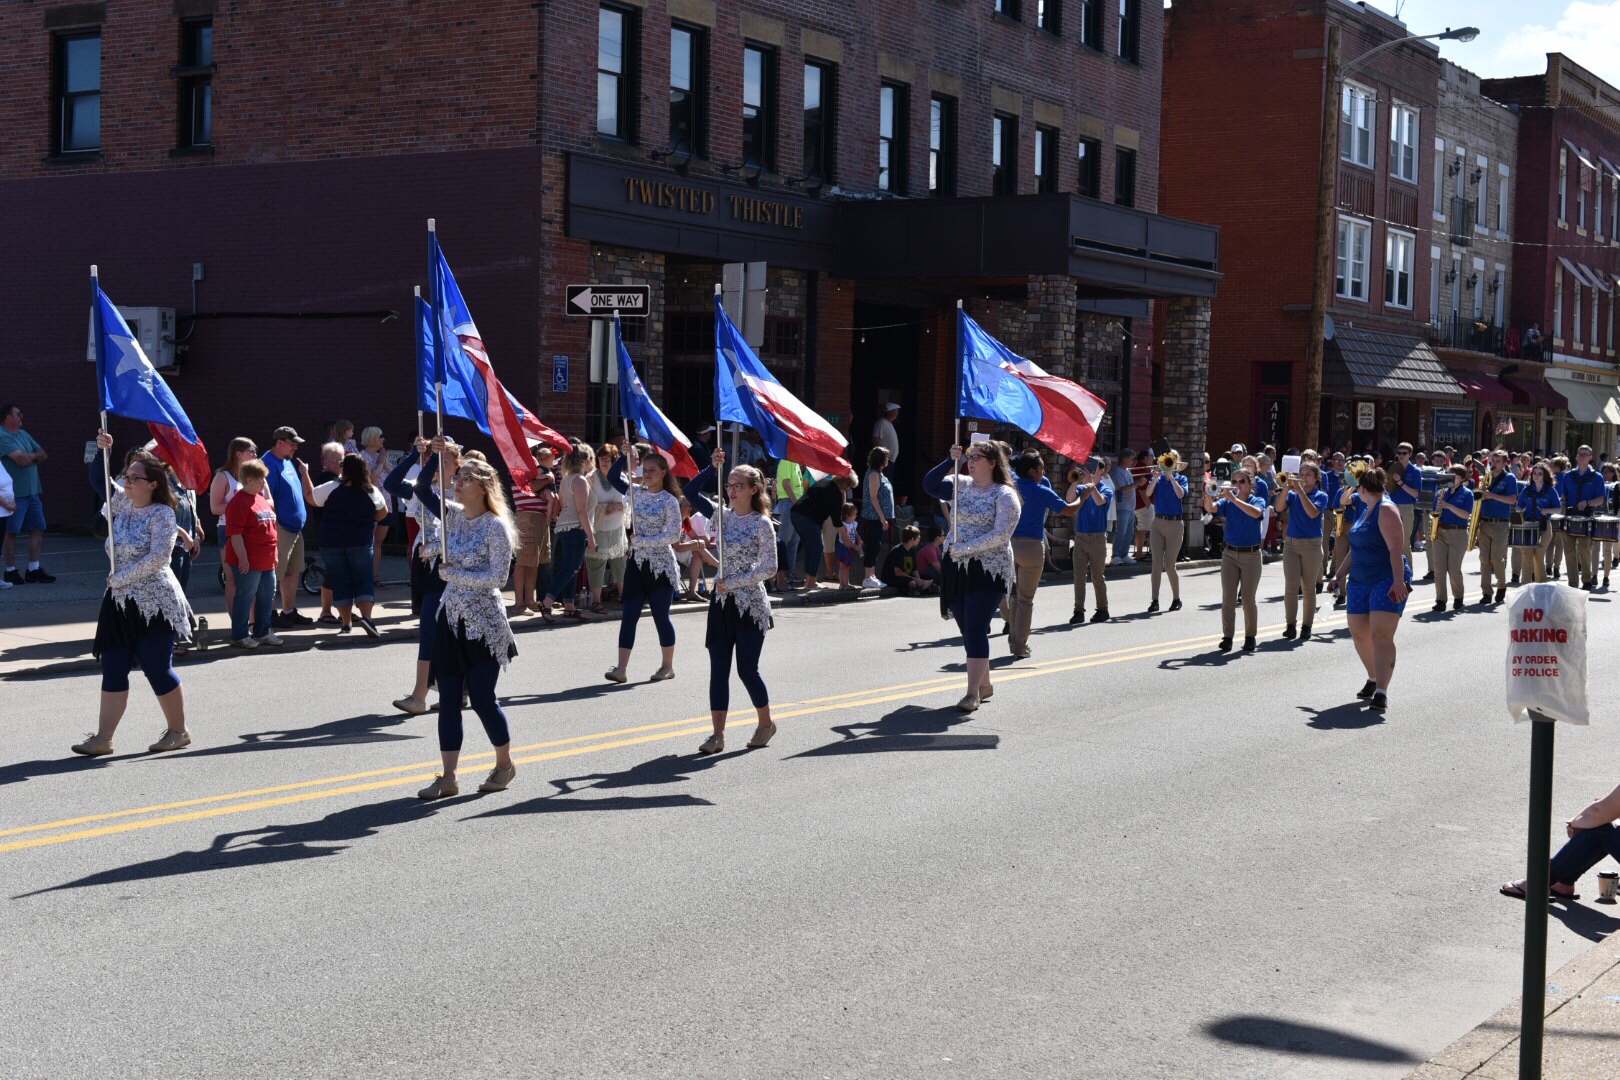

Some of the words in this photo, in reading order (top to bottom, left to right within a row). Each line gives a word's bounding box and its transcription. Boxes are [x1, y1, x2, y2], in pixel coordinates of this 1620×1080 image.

[624, 176, 715, 214] TWISTED
[729, 195, 804, 229] THISTLE
[591, 294, 613, 306] ONE
[617, 294, 640, 306] WAY
[1523, 608, 1544, 622] NO
[1511, 628, 1568, 643] ARKING
[1512, 655, 1523, 664] BY
[1525, 655, 1558, 664] ORDER
[1512, 668, 1522, 677] OF
[1524, 667, 1559, 677] POLICE
